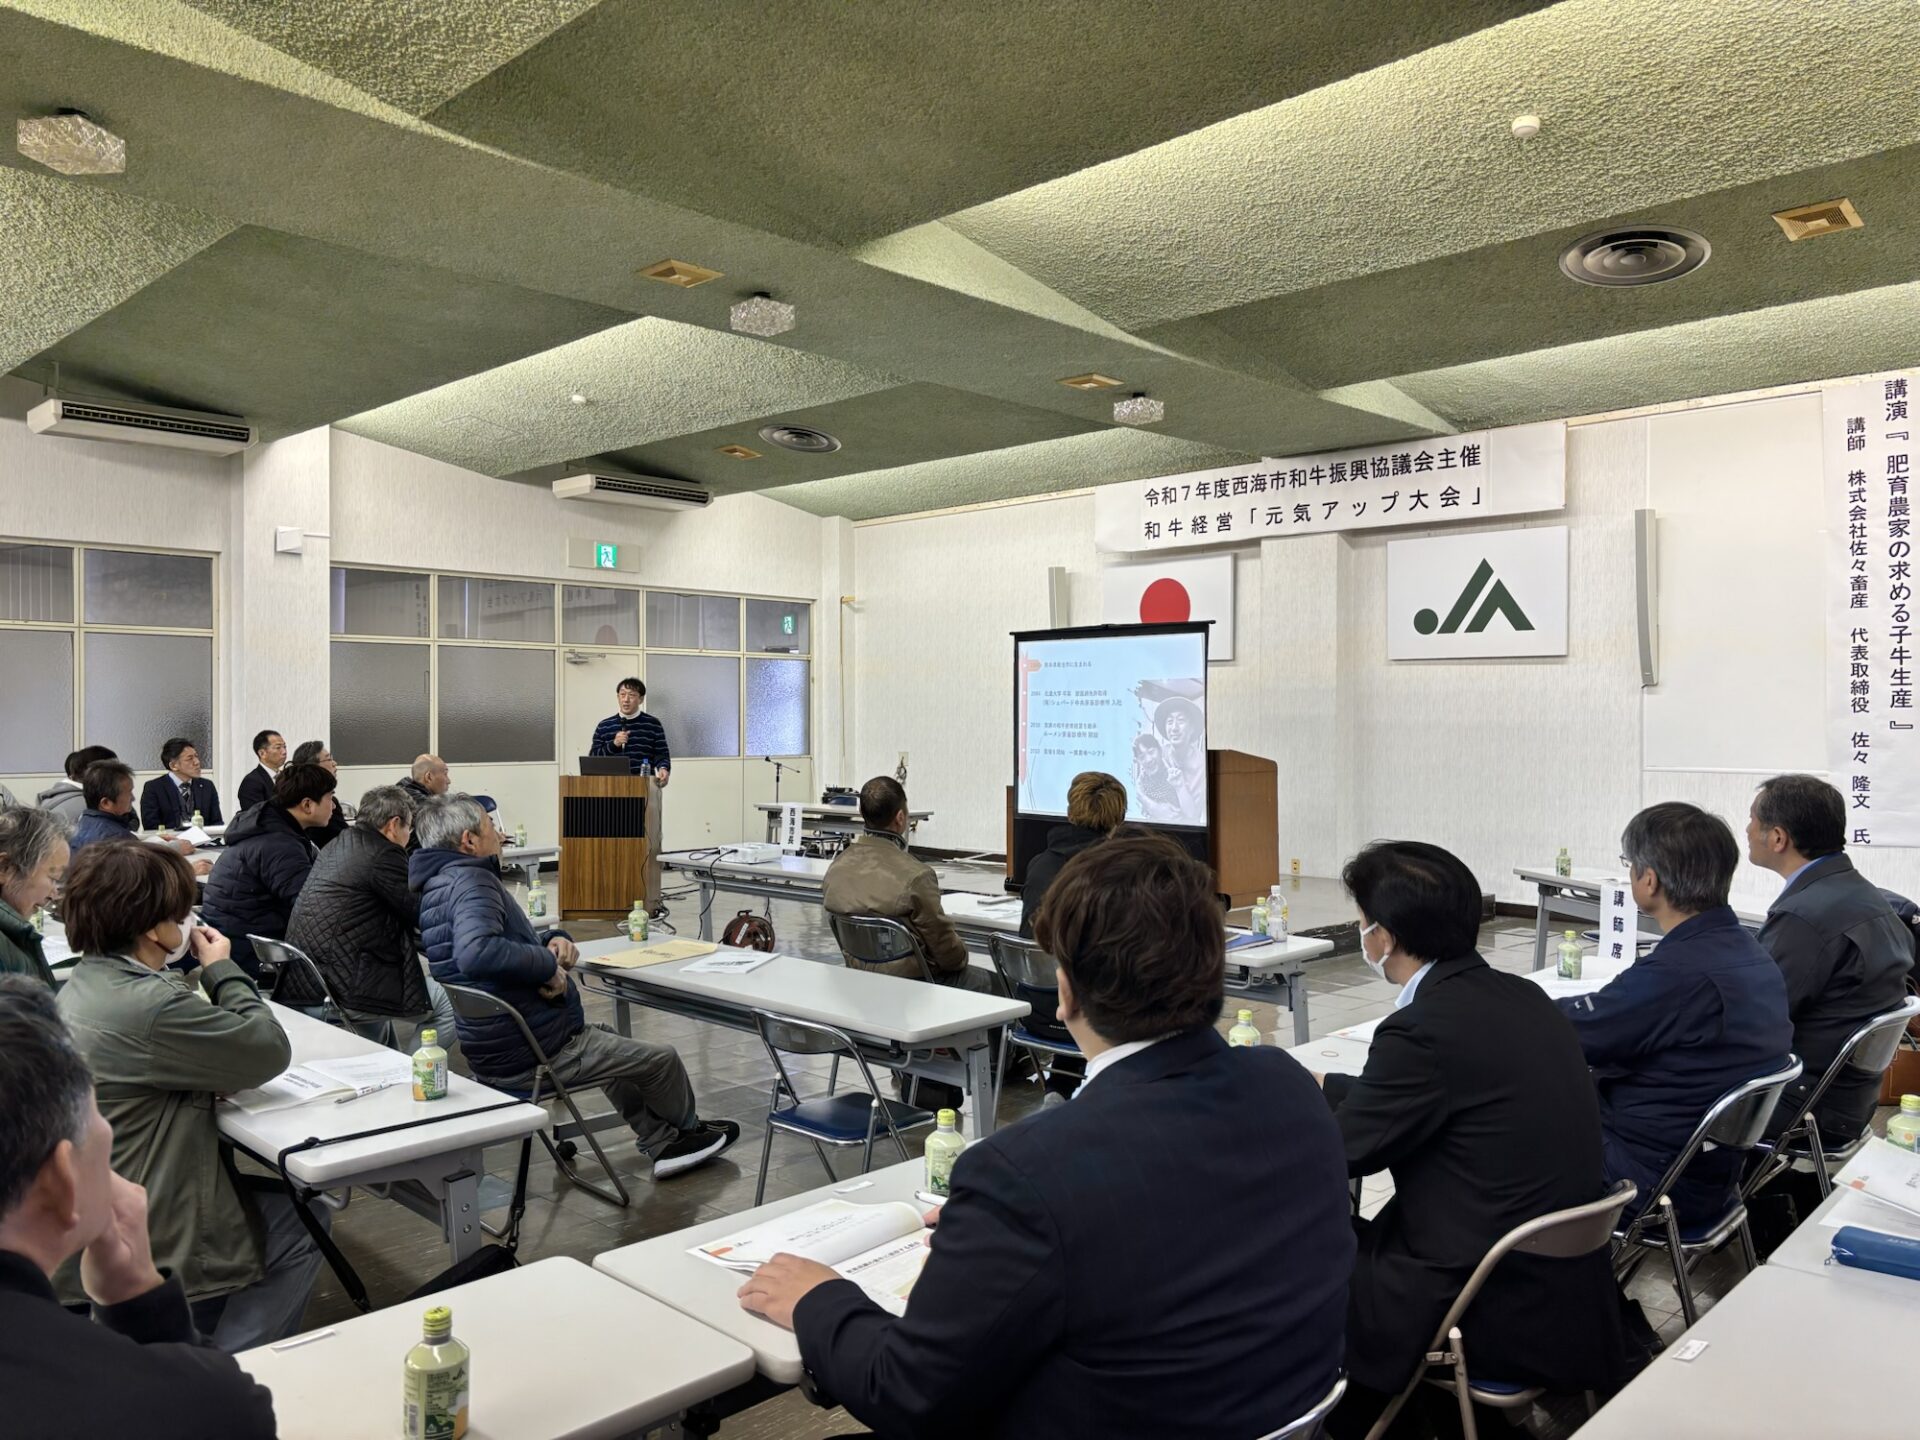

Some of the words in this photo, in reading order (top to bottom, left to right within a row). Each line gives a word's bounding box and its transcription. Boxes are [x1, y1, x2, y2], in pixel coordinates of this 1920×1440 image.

[1847, 417, 1866, 452] 講師
[1144, 444, 1482, 509] 令和7年度西海市和牛振興協議会主催
[1144, 485, 1482, 540] 和牛経営「元気アップ大会」
[1848, 469, 1869, 610] 株式会社佐々畜産
[1884, 379, 1914, 731] 講演『肥育農家の求める子牛生産』
[1850, 627, 1870, 714] 代表取締役
[1851, 731, 1870, 765] 佐々
[1852, 775, 1871, 809] 隆文
[1853, 828, 1871, 845] 氏
[1611, 890, 1624, 959] 講師席
